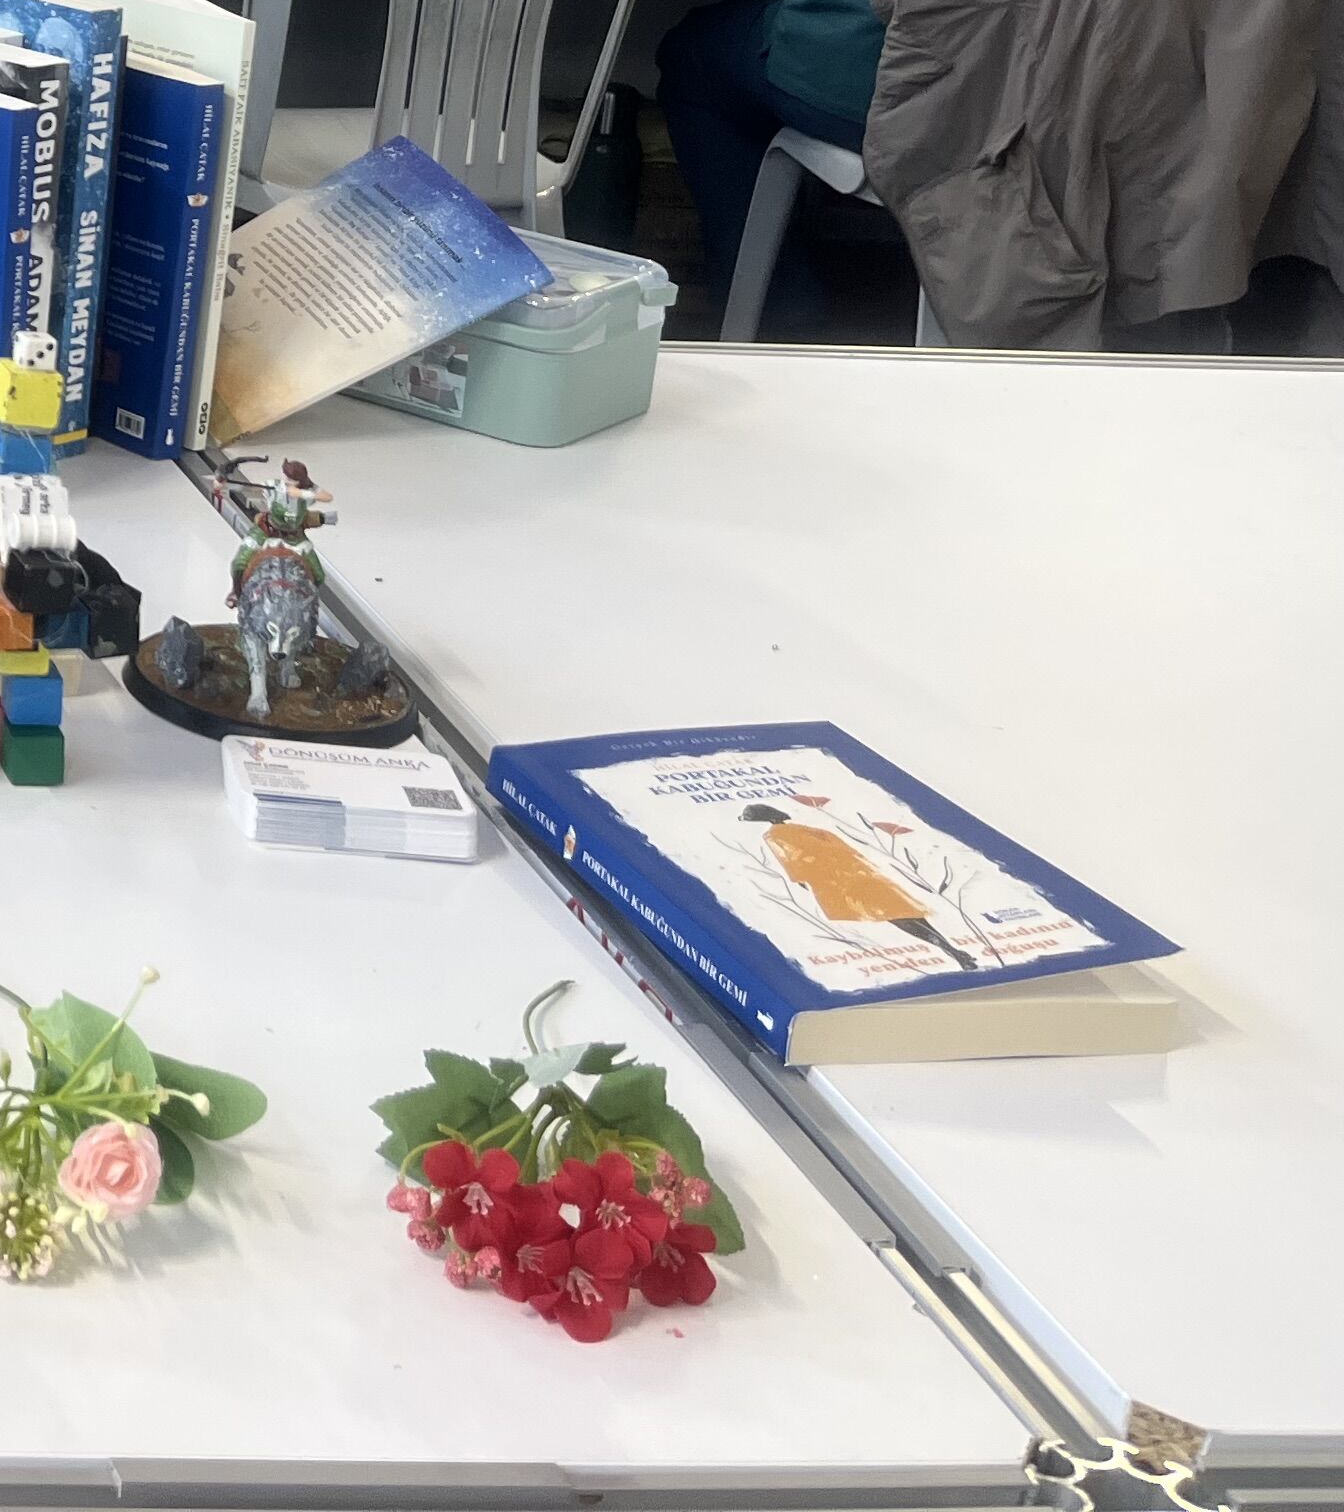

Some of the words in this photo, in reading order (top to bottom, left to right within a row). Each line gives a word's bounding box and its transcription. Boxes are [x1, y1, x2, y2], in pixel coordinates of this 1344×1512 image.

[31, 79, 61, 224] MOBIUS
[83, 52, 114, 180] HAFIZA
[75, 210, 101, 289] SİNAN
[65, 297, 91, 403] MEYDAN
[502, 778, 528, 809] HİLAL
[527, 801, 558, 836] ÇATAK
[648, 773, 813, 796] KABUĞUNDAN
[653, 765, 780, 784] PORTAKAL
[690, 789, 736, 804] BİR
[738, 786, 799, 801] GEMİ
[582, 850, 630, 903] PORTAKAL
[630, 893, 699, 963] KABUĞUNDAN
[699, 956, 718, 981] BİR
[718, 975, 749, 1007] GEMİ
